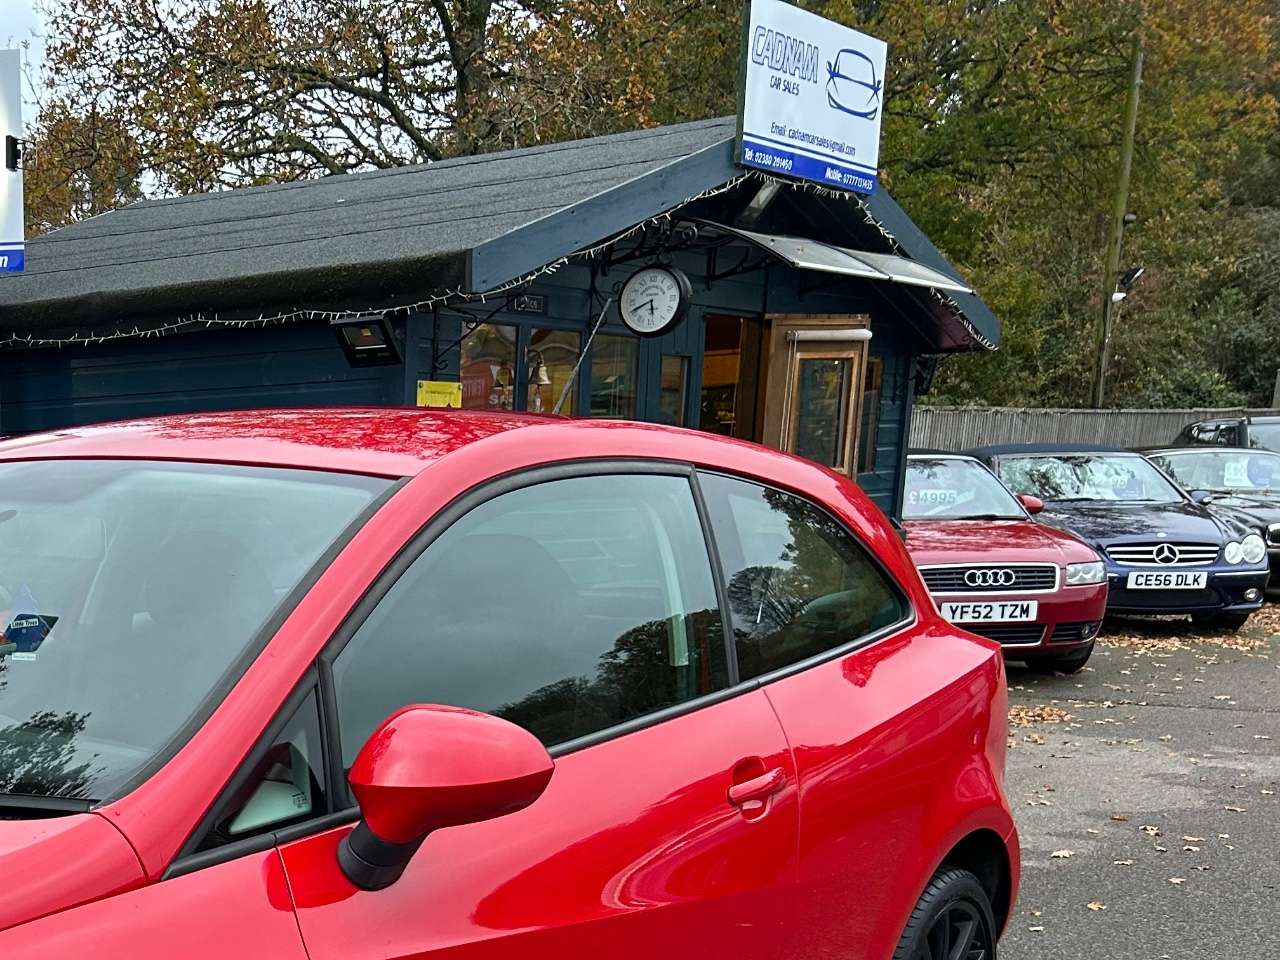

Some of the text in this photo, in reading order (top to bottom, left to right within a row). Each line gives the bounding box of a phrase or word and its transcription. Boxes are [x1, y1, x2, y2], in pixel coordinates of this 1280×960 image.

[751, 25, 819, 84] CADNAM
[770, 75, 800, 96] CAR SALES
[1135, 573, 1202, 587] CE56 DLK
[949, 603, 1031, 620] YF52 TZM
